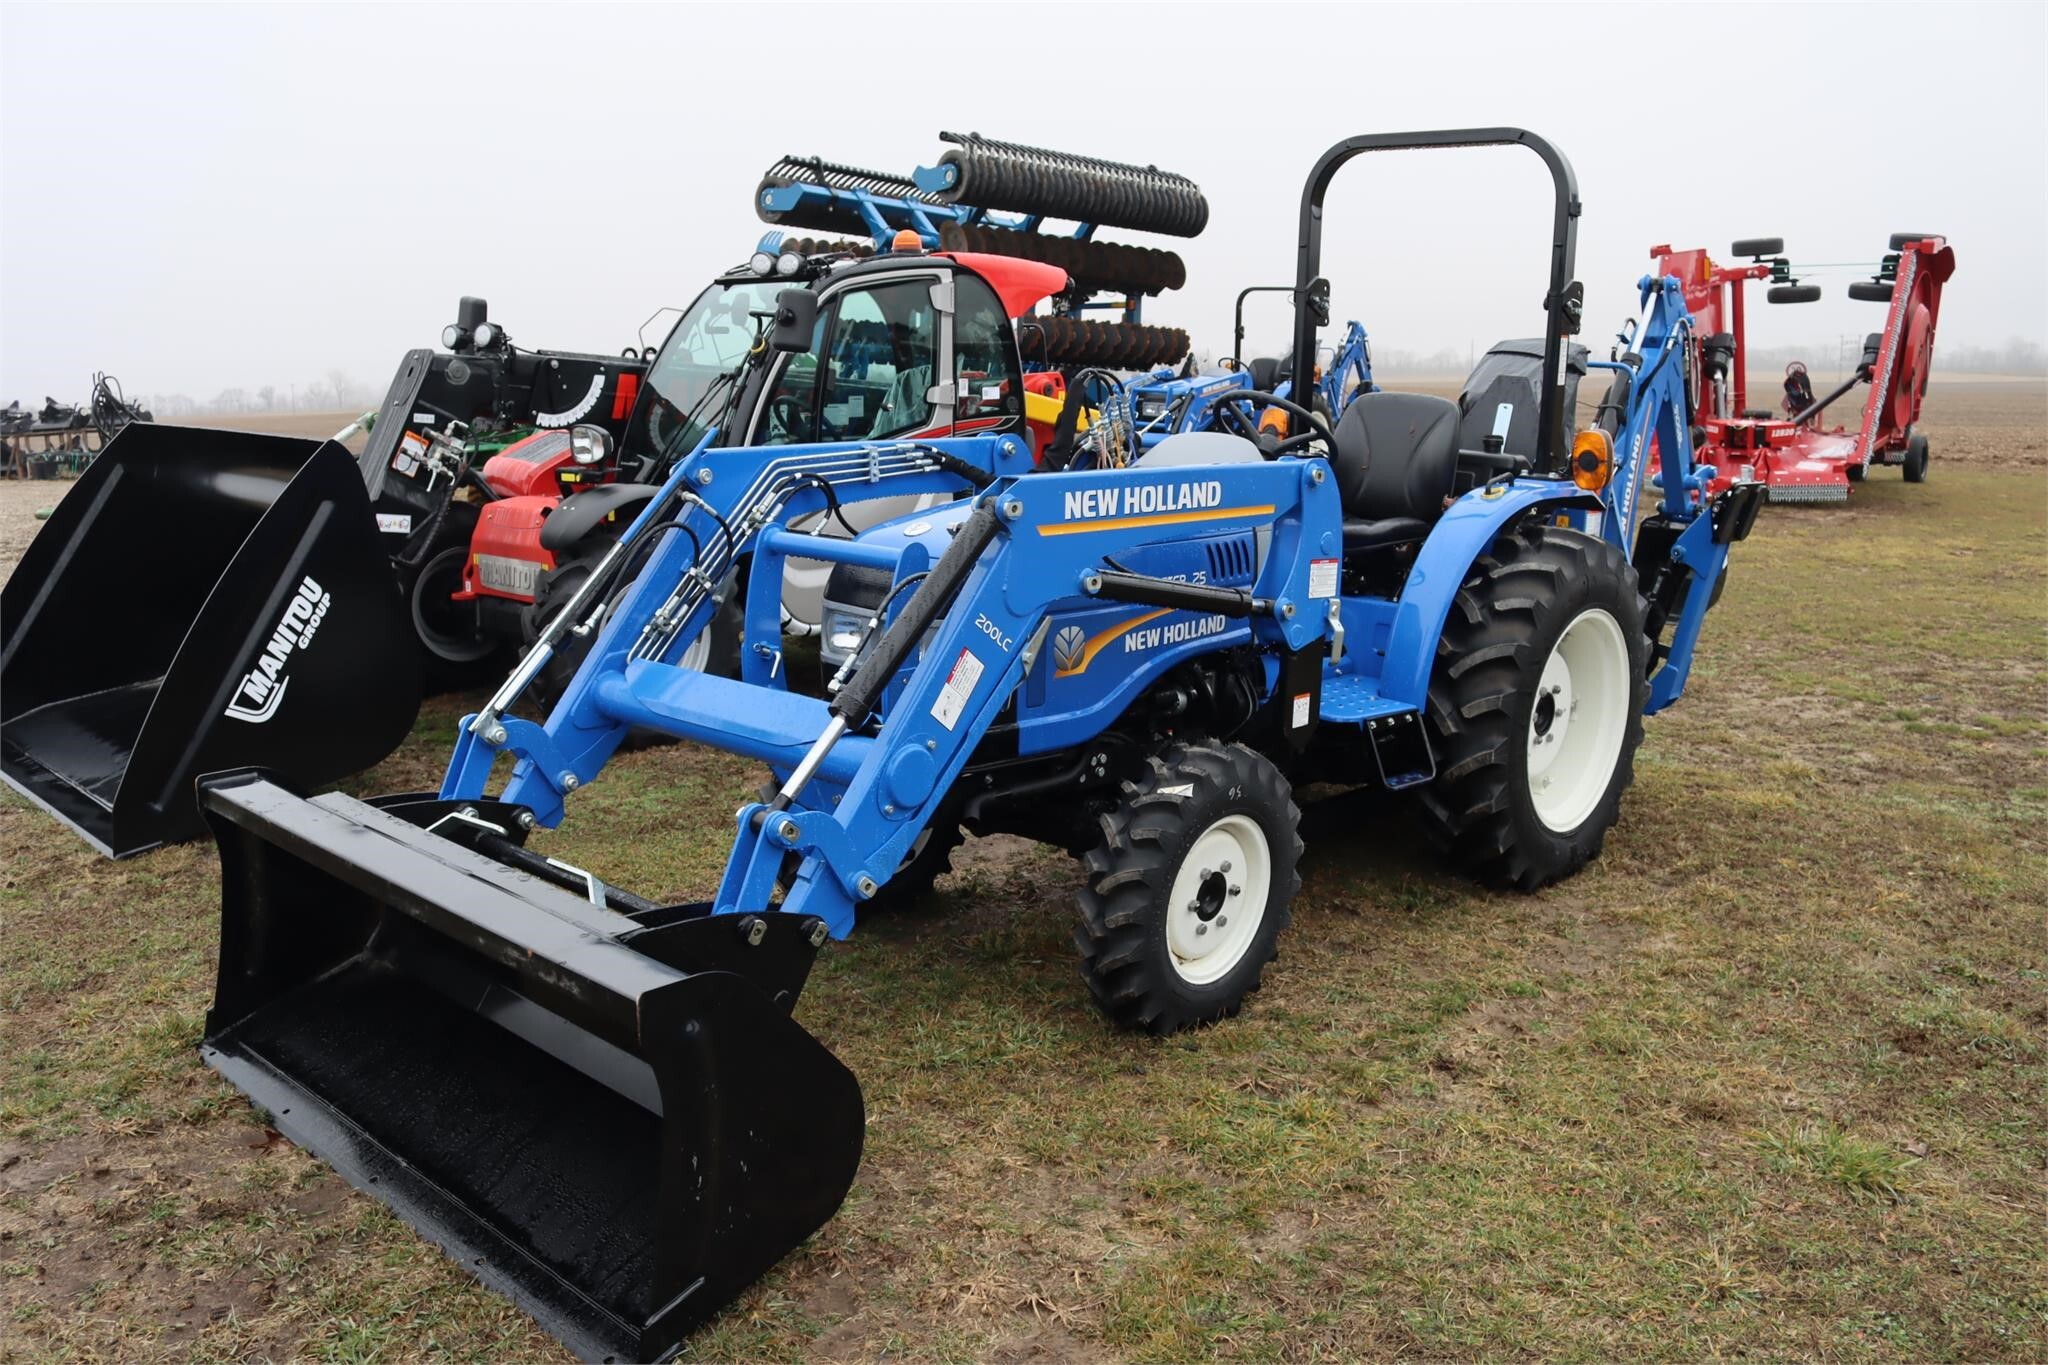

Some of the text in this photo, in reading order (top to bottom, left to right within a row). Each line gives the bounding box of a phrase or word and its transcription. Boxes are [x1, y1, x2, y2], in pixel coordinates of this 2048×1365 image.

[1065, 481, 1221, 519] NEW HOLLAND
[1192, 570, 1207, 585] 25
[243, 575, 323, 705] MANITOU
[298, 592, 331, 650] GROUP
[974, 612, 1013, 653] 200LC
[1125, 615, 1225, 653] NEW HOLLAND
